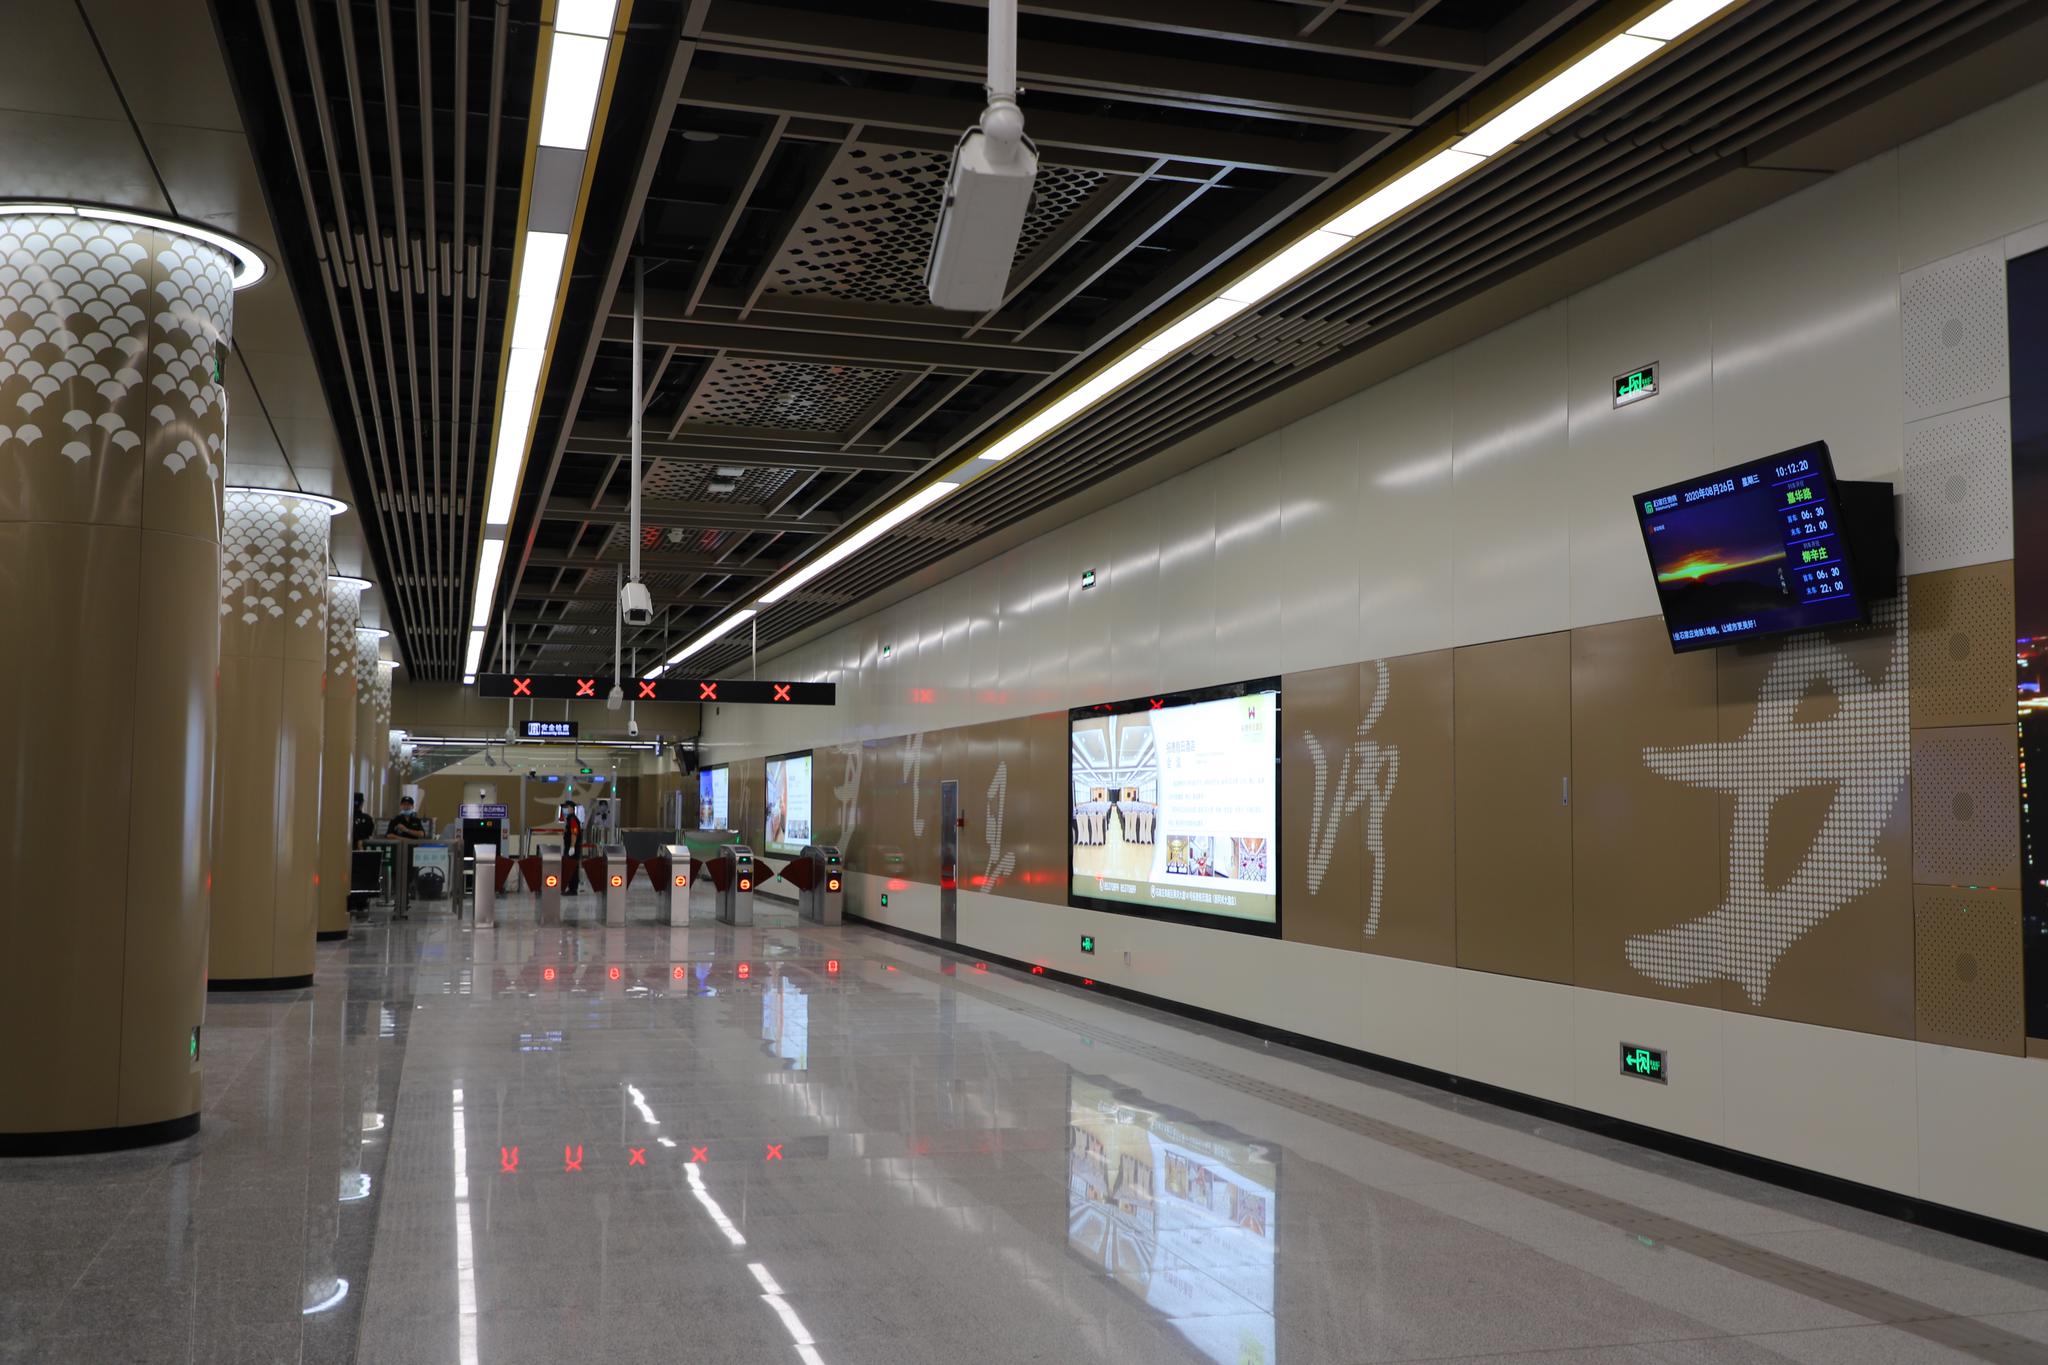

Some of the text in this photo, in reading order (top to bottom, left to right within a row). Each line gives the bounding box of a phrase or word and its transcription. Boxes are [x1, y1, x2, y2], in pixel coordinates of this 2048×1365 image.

[1775, 460, 1809, 478] 10:12:20
[1684, 474, 1761, 503] 2020年08月26日 星期三
[1786, 488, 1812, 505] 嘉华路
[1801, 546, 1829, 563] 柳辛庄
[540, 723, 570, 732] 安全检查
